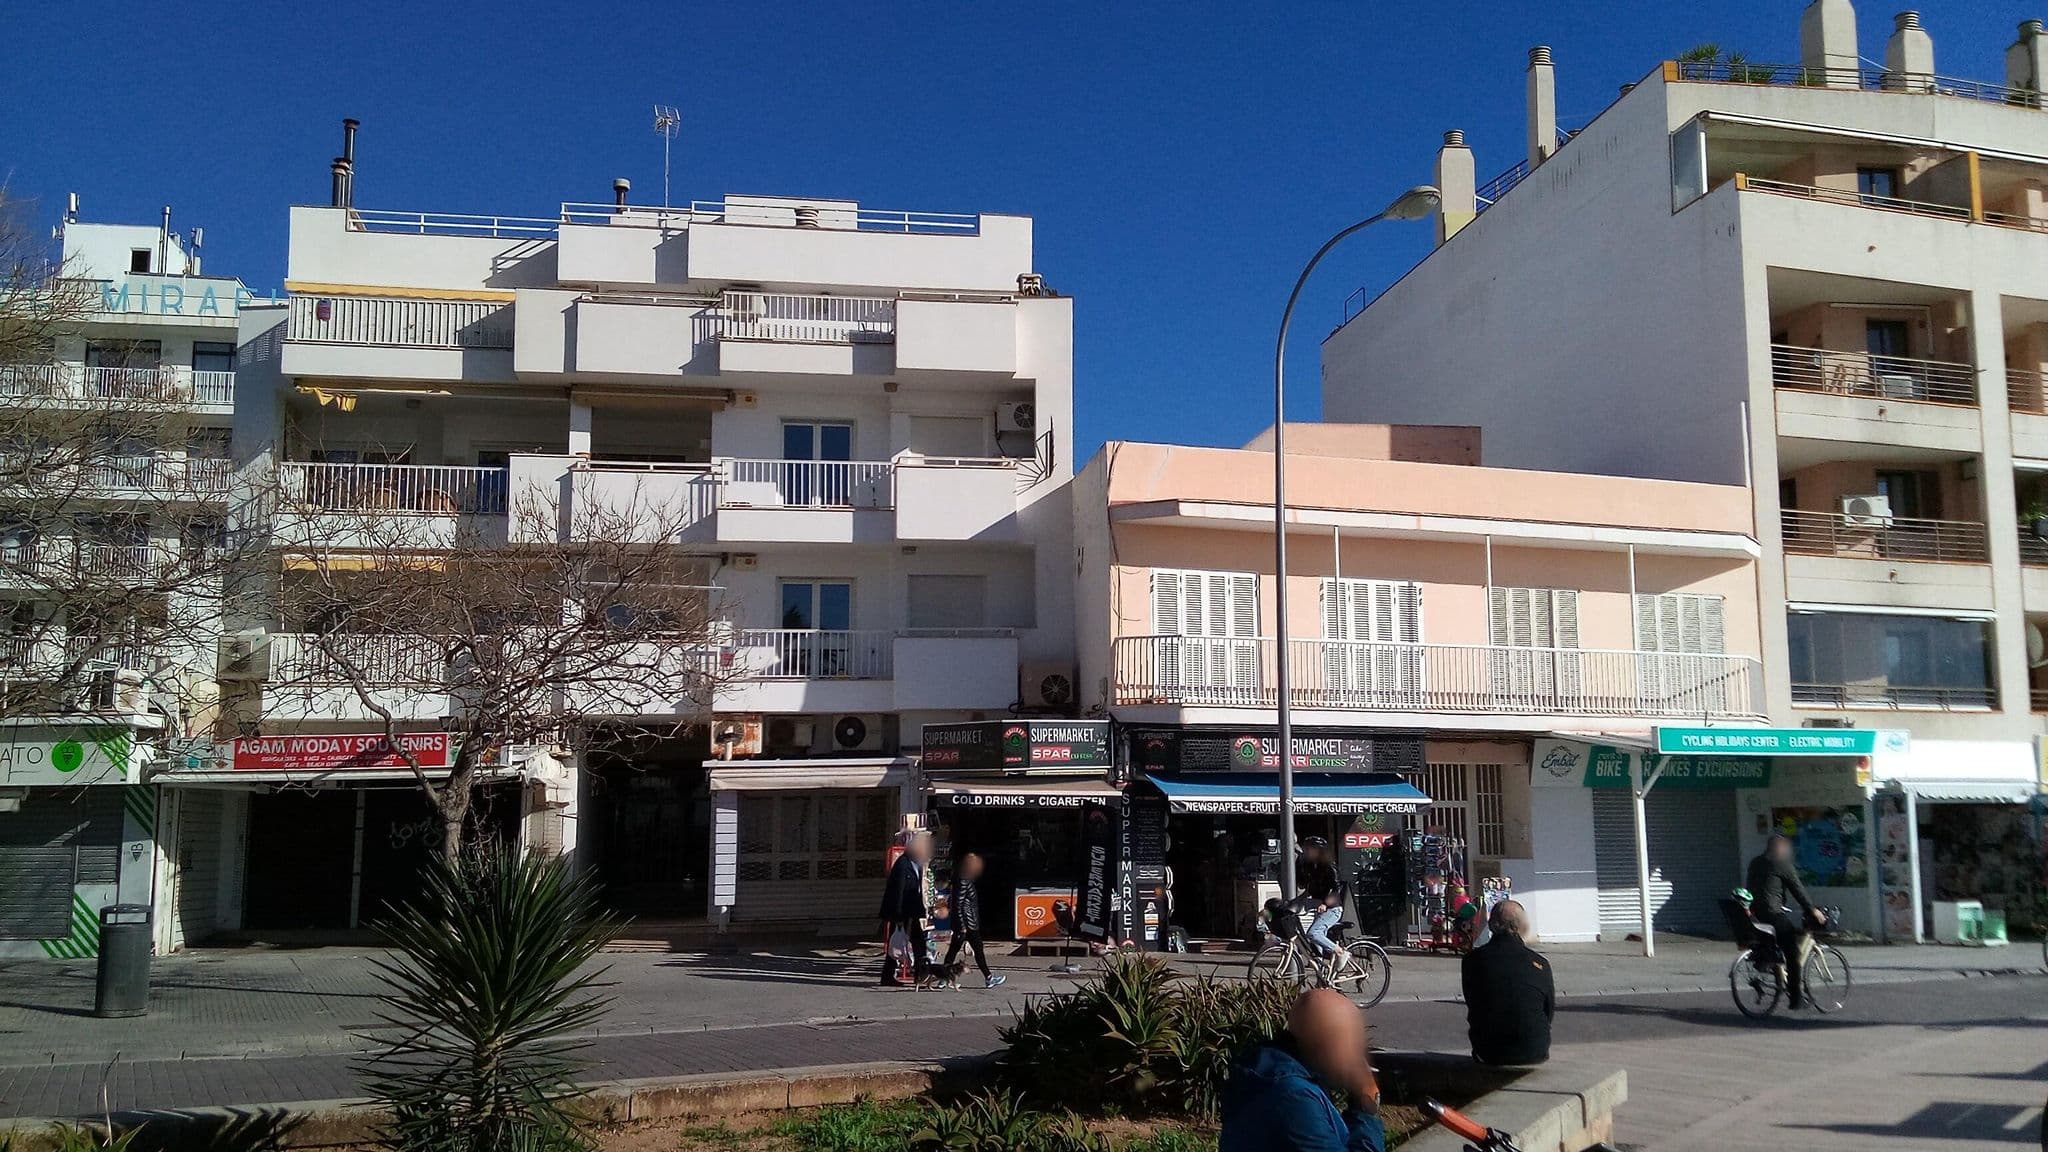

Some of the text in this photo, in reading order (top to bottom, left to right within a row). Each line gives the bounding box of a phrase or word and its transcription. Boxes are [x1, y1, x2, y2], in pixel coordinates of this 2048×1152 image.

[924, 729, 983, 745] SUPERMARKET
[1031, 727, 1095, 743] SUPERMARKET
[1682, 735, 1713, 747] CYCLING
[1751, 736, 1780, 748] CENTER
[1789, 737, 1823, 748] ELECTRIC
[238, 739, 286, 754] AGAM
[291, 738, 341, 753] MODA
[356, 736, 443, 752] SOUENIRS
[1262, 737, 1343, 755] SURMARKET
[924, 751, 960, 761] SPAR
[1032, 749, 1071, 760] SPAR
[1309, 758, 1347, 767] EXPRESS
[1595, 759, 1623, 777] BIKE
[1695, 760, 1764, 778] EXCURSIONS
[952, 795, 982, 806] COLD
[985, 795, 1025, 806] DRINKS
[1186, 802, 1244, 813] NEWSPAPER
[1250, 802, 1276, 813] FRUIT
[1315, 803, 1364, 814] BAGUETTE
[1369, 803, 1384, 813] ICE
[1385, 802, 1417, 814] CREAM
[1121, 794, 1133, 939] SUPERMARKET
